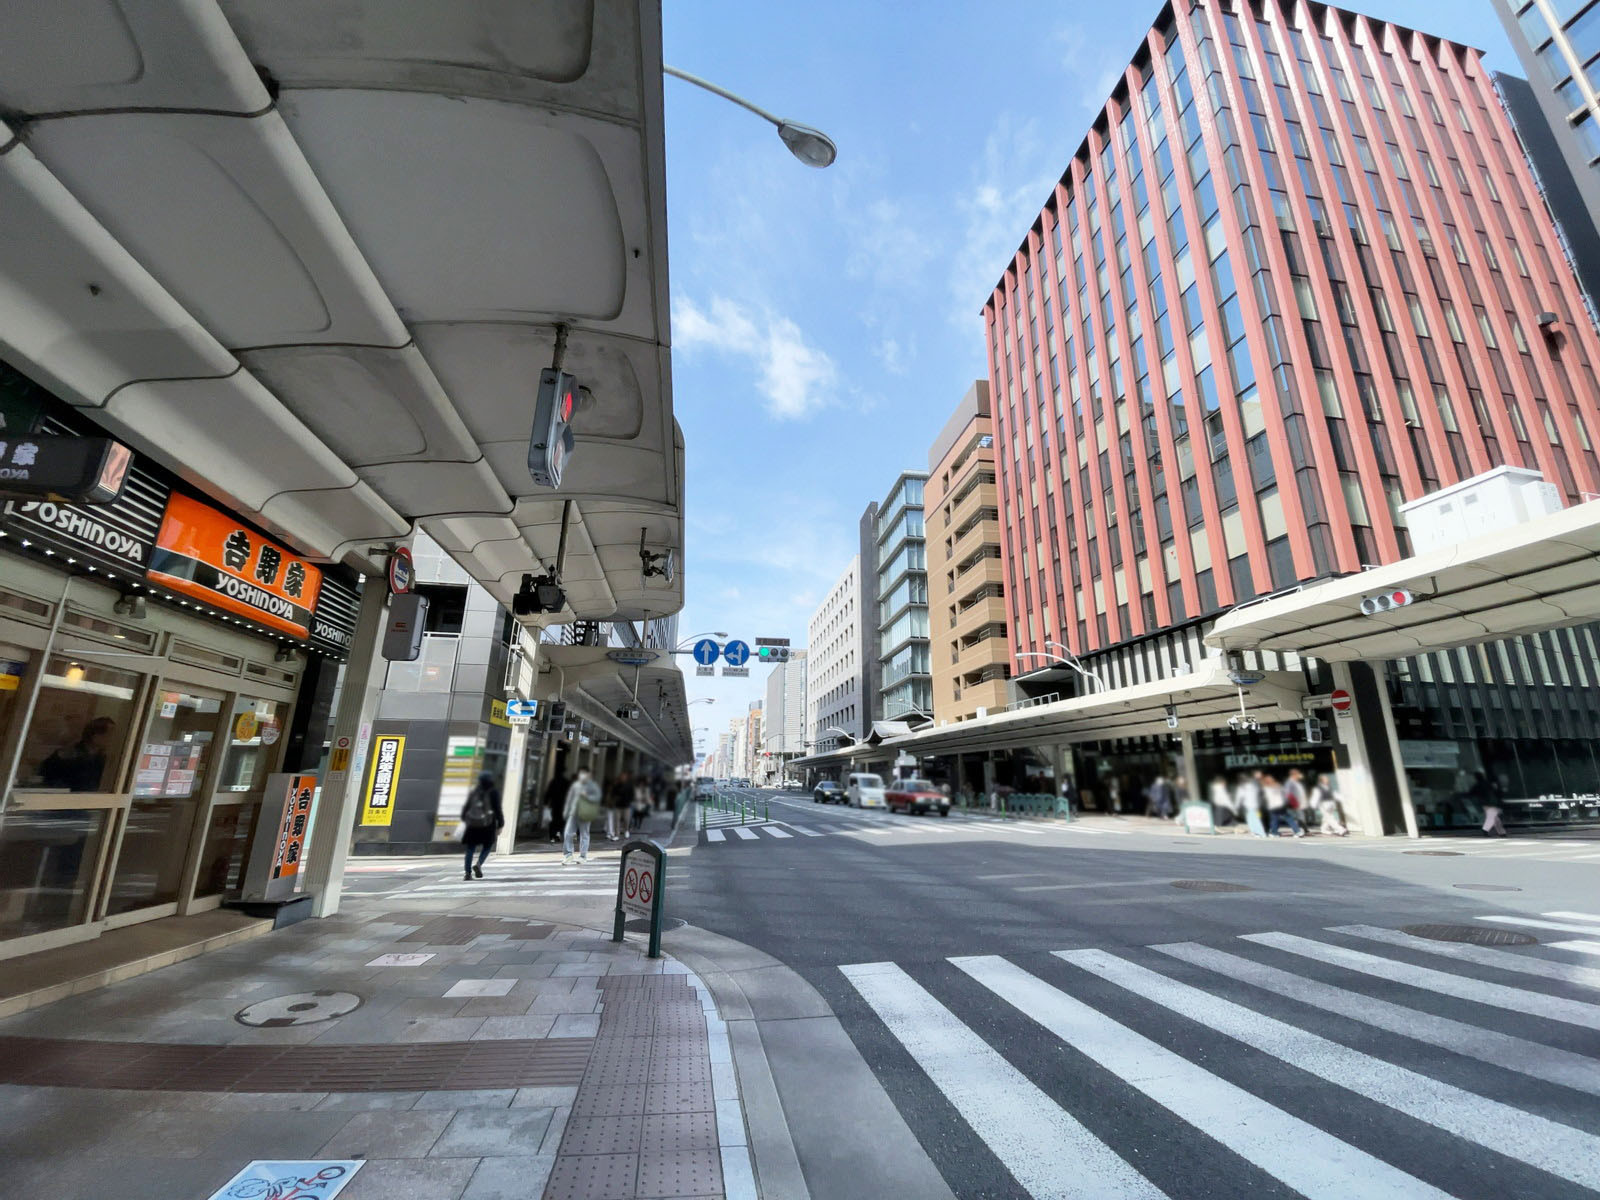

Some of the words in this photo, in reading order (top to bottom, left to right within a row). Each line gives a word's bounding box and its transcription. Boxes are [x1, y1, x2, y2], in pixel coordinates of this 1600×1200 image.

[215, 572, 293, 620] YOSHINOYA
[222, 529, 306, 599] 吉野家
[276, 788, 299, 866] YOSHINOYA
[285, 787, 311, 865] 吉野家
